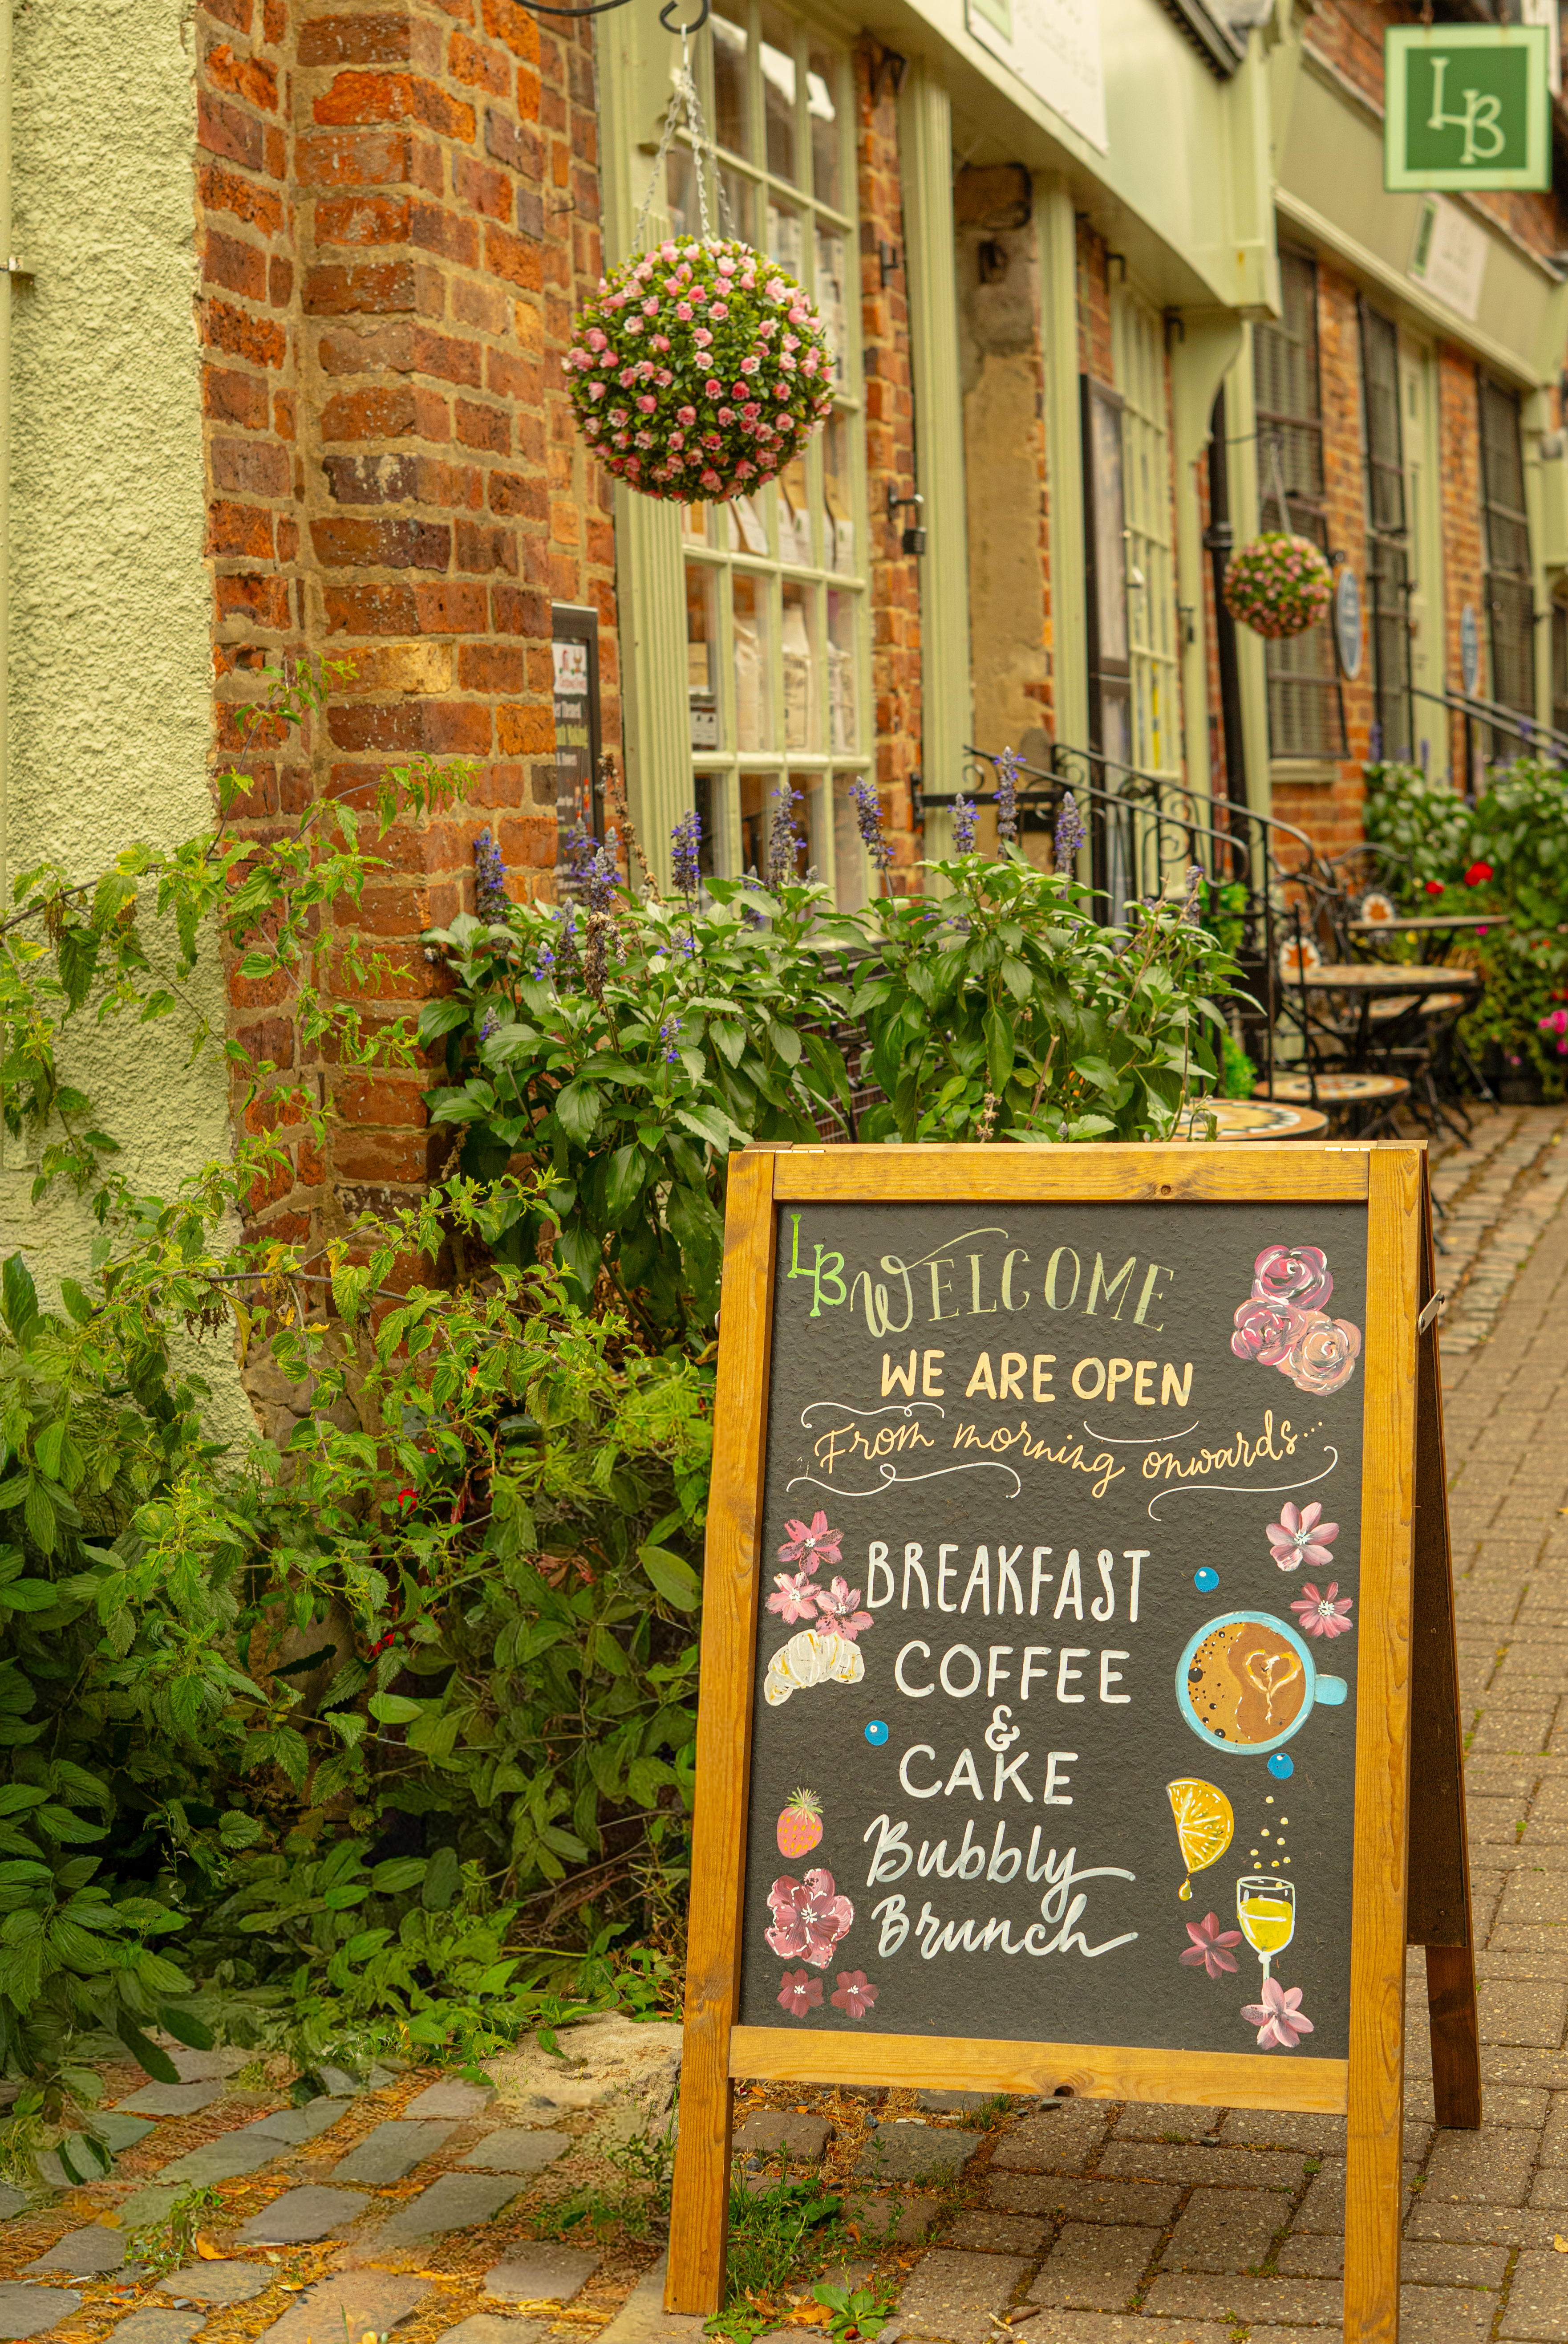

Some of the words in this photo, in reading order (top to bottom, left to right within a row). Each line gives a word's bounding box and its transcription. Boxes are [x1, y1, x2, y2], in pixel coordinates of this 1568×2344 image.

[850, 1227, 1174, 1338] WELCOME
[881, 1349, 945, 1397] WE
[965, 1351, 1057, 1403] ARE
[1071, 1357, 1193, 1407] OPEN
[814, 1421, 935, 1475] From
[952, 1420, 1126, 1499] morning
[866, 1541, 1151, 1622] BREAKFAST
[894, 1640, 1131, 1704] COFFEE
[985, 1704, 1021, 1751] &
[899, 1744, 1079, 1805] CAKE
[863, 1814, 1136, 1924] Bubbly
[871, 1893, 1139, 1960] Brunch
